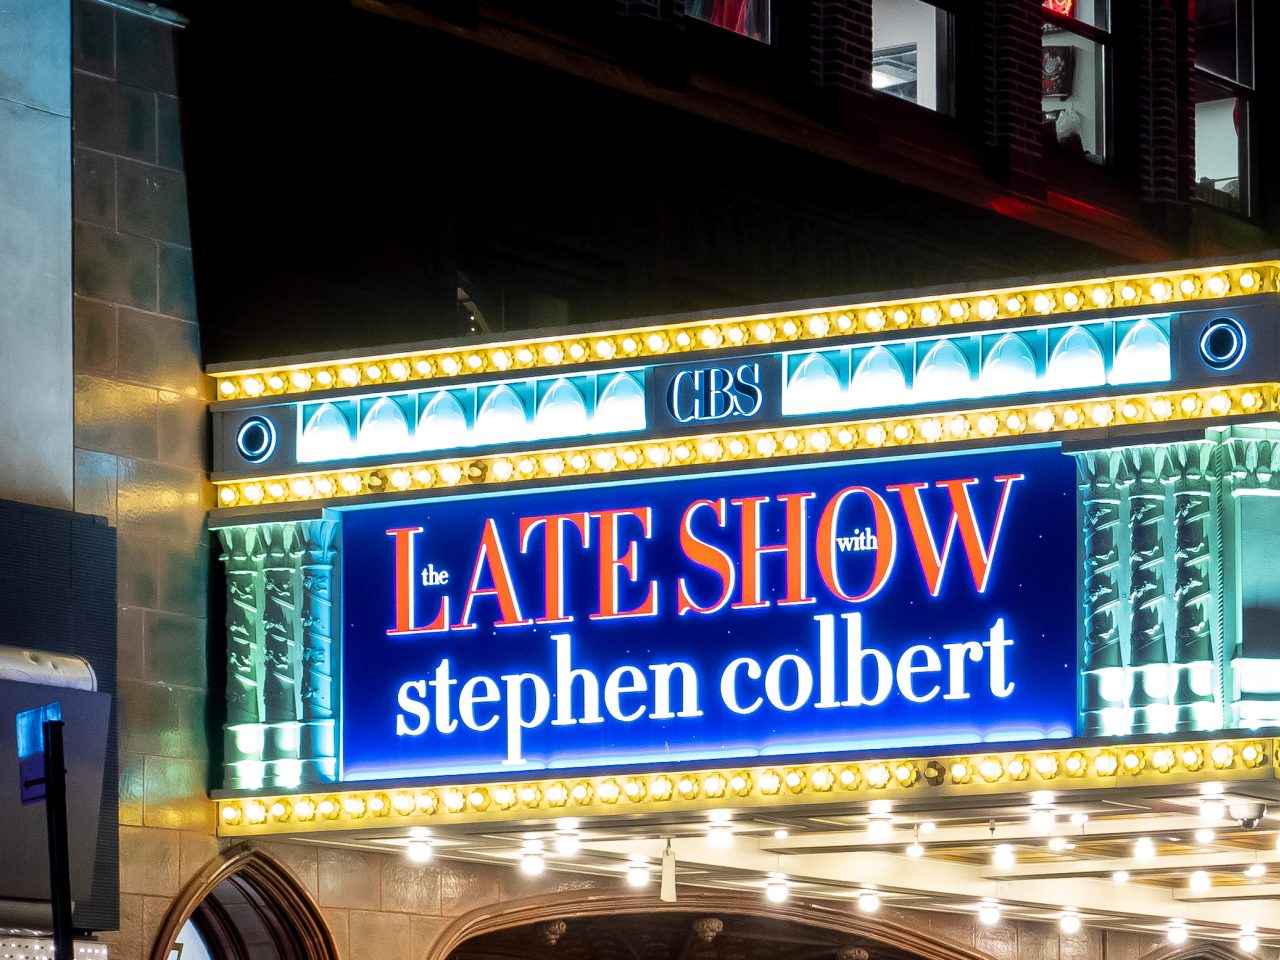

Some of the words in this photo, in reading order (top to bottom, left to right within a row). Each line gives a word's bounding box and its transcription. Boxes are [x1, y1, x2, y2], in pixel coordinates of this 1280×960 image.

[666, 363, 762, 423] CBS
[386, 507, 659, 636] LATE
[677, 474, 1025, 616] SHOW
[836, 528, 879, 553] with
[421, 565, 449, 587] the
[395, 633, 704, 766] stephen
[719, 612, 1016, 715] colbert
